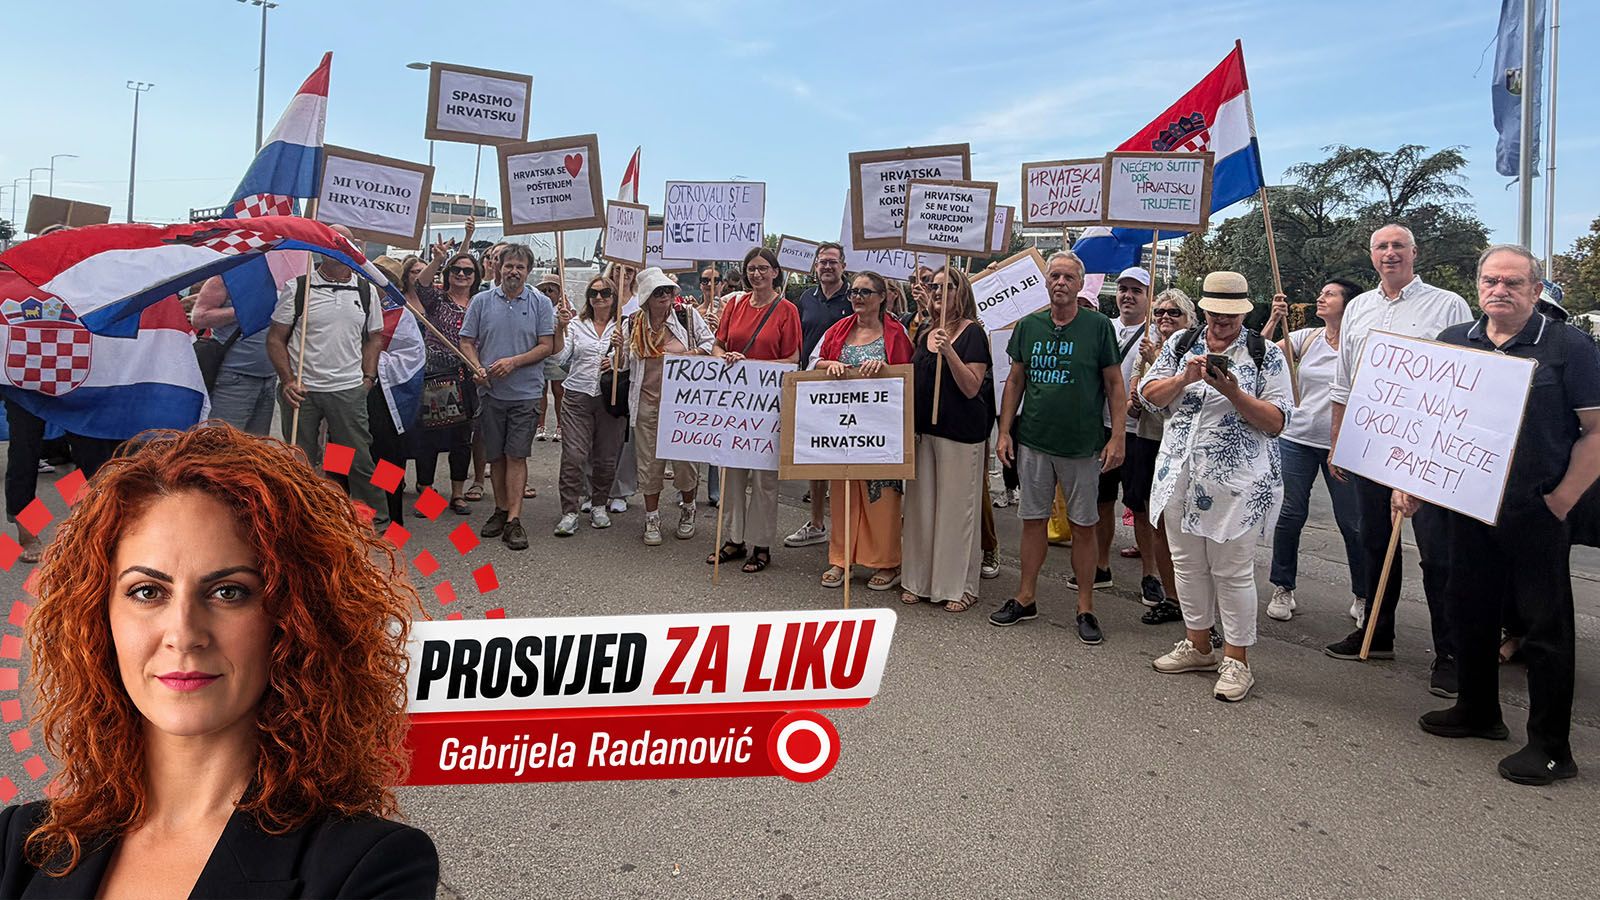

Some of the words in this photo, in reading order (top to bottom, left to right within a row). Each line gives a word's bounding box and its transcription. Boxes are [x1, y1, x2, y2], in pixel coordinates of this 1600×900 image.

[452, 90, 513, 108] SPASIMO
[446, 104, 516, 123] HRVATSKU
[513, 168, 556, 180] HRVATSKA
[557, 166, 567, 175] SE
[880, 167, 942, 181] HRVATSKA
[1120, 160, 1163, 174] NEĆEMO
[1166, 159, 1200, 173] ŠUTIT
[1029, 167, 1101, 187] HRVATSKA
[1131, 173, 1149, 183] DOK
[332, 175, 353, 188] MI
[354, 179, 412, 199] VOLIMO
[526, 179, 573, 192] POŠTENJEM
[883, 184, 896, 194] SE
[898, 184, 906, 193] N
[1048, 185, 1082, 201] NIJE
[1136, 181, 1196, 196] HRVATSKU
[530, 197, 535, 206] I
[536, 193, 572, 205] ISTINOM
[668, 184, 724, 204] OTROVALI
[729, 186, 751, 204] STE
[879, 196, 906, 206] KORU
[924, 191, 973, 203] HRVATSKA
[327, 192, 410, 216] HRVATSKU!
[925, 202, 935, 210] SE
[937, 203, 948, 211] NE
[949, 204, 970, 213] VOLI
[1030, 190, 1101, 218] DEPONIJ!
[1140, 198, 1197, 213] TRUJETE!
[667, 204, 694, 221] NAM
[920, 212, 974, 223] KORUPCIJOM
[666, 221, 711, 243] NEĆETE
[715, 222, 719, 243] I
[929, 232, 960, 243] LAŽIMA
[645, 245, 663, 254] DOS
[781, 247, 803, 258] DOSTA
[977, 285, 1020, 312] DOSTA
[1020, 274, 1040, 291] JE!
[1031, 341, 1042, 354] A
[1030, 355, 1057, 369] OVO
[1369, 342, 1482, 392] OTROVALI
[665, 359, 748, 386] TROSKA
[674, 388, 781, 413] MATERINA
[809, 391, 870, 405] VRIJEME
[872, 391, 889, 403] JE
[1367, 378, 1413, 408] STE
[1416, 392, 1469, 431] NAM
[673, 410, 764, 432] POZDRAV
[839, 414, 857, 426] ZA
[671, 429, 723, 448] DUGOG
[731, 435, 774, 454] RATA
[810, 435, 886, 449] HRVATSKU
[1354, 405, 1423, 445] OKOLIŠ
[1431, 429, 1500, 474] NEĆETE
[1362, 438, 1371, 459] I
[1384, 446, 1466, 494] PAMET!
